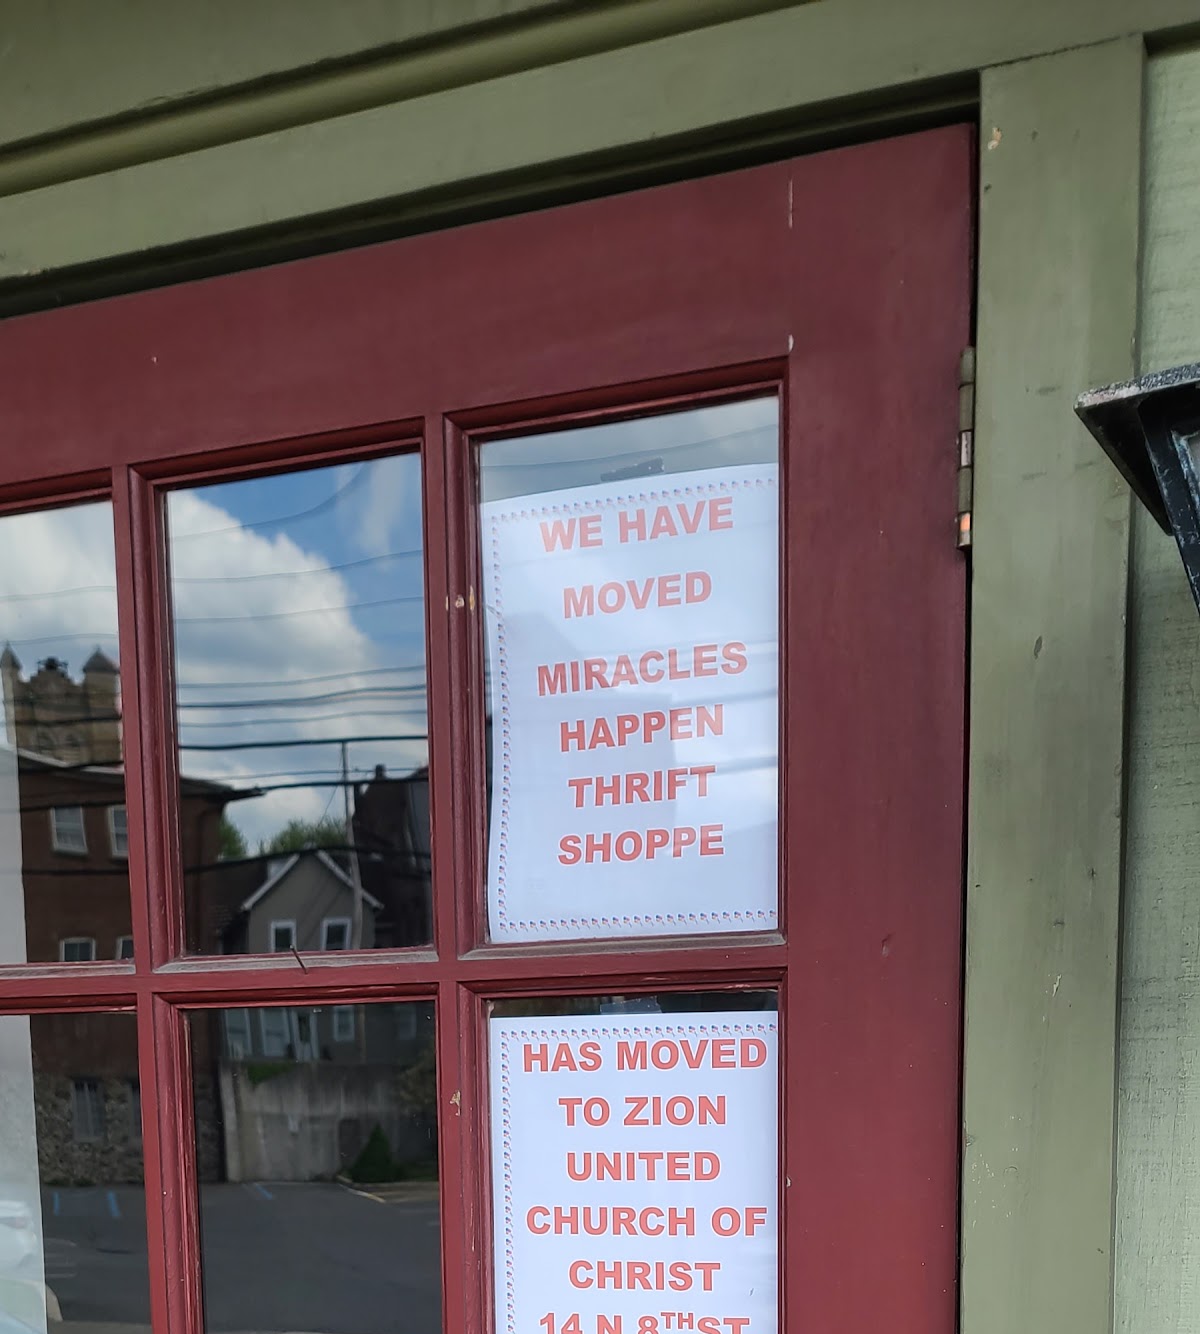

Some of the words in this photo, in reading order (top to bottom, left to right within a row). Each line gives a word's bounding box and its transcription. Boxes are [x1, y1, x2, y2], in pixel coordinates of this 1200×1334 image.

[540, 515, 603, 552] WE
[618, 496, 734, 543] HAVE
[563, 571, 712, 618] MOVED
[537, 641, 749, 696] MIRACLES
[560, 704, 724, 752] HAPPEN
[568, 765, 716, 807] THRIFT
[557, 824, 725, 865] SHOPPE
[523, 1041, 602, 1072] HAS
[616, 1039, 768, 1070] MOVED
[559, 1097, 610, 1126] TO
[623, 1096, 726, 1125] ZION
[566, 1152, 721, 1181] UNITED
[526, 1206, 695, 1236] CHURCH
[711, 1207, 768, 1236] OF
[569, 1260, 721, 1291] CHRIST
